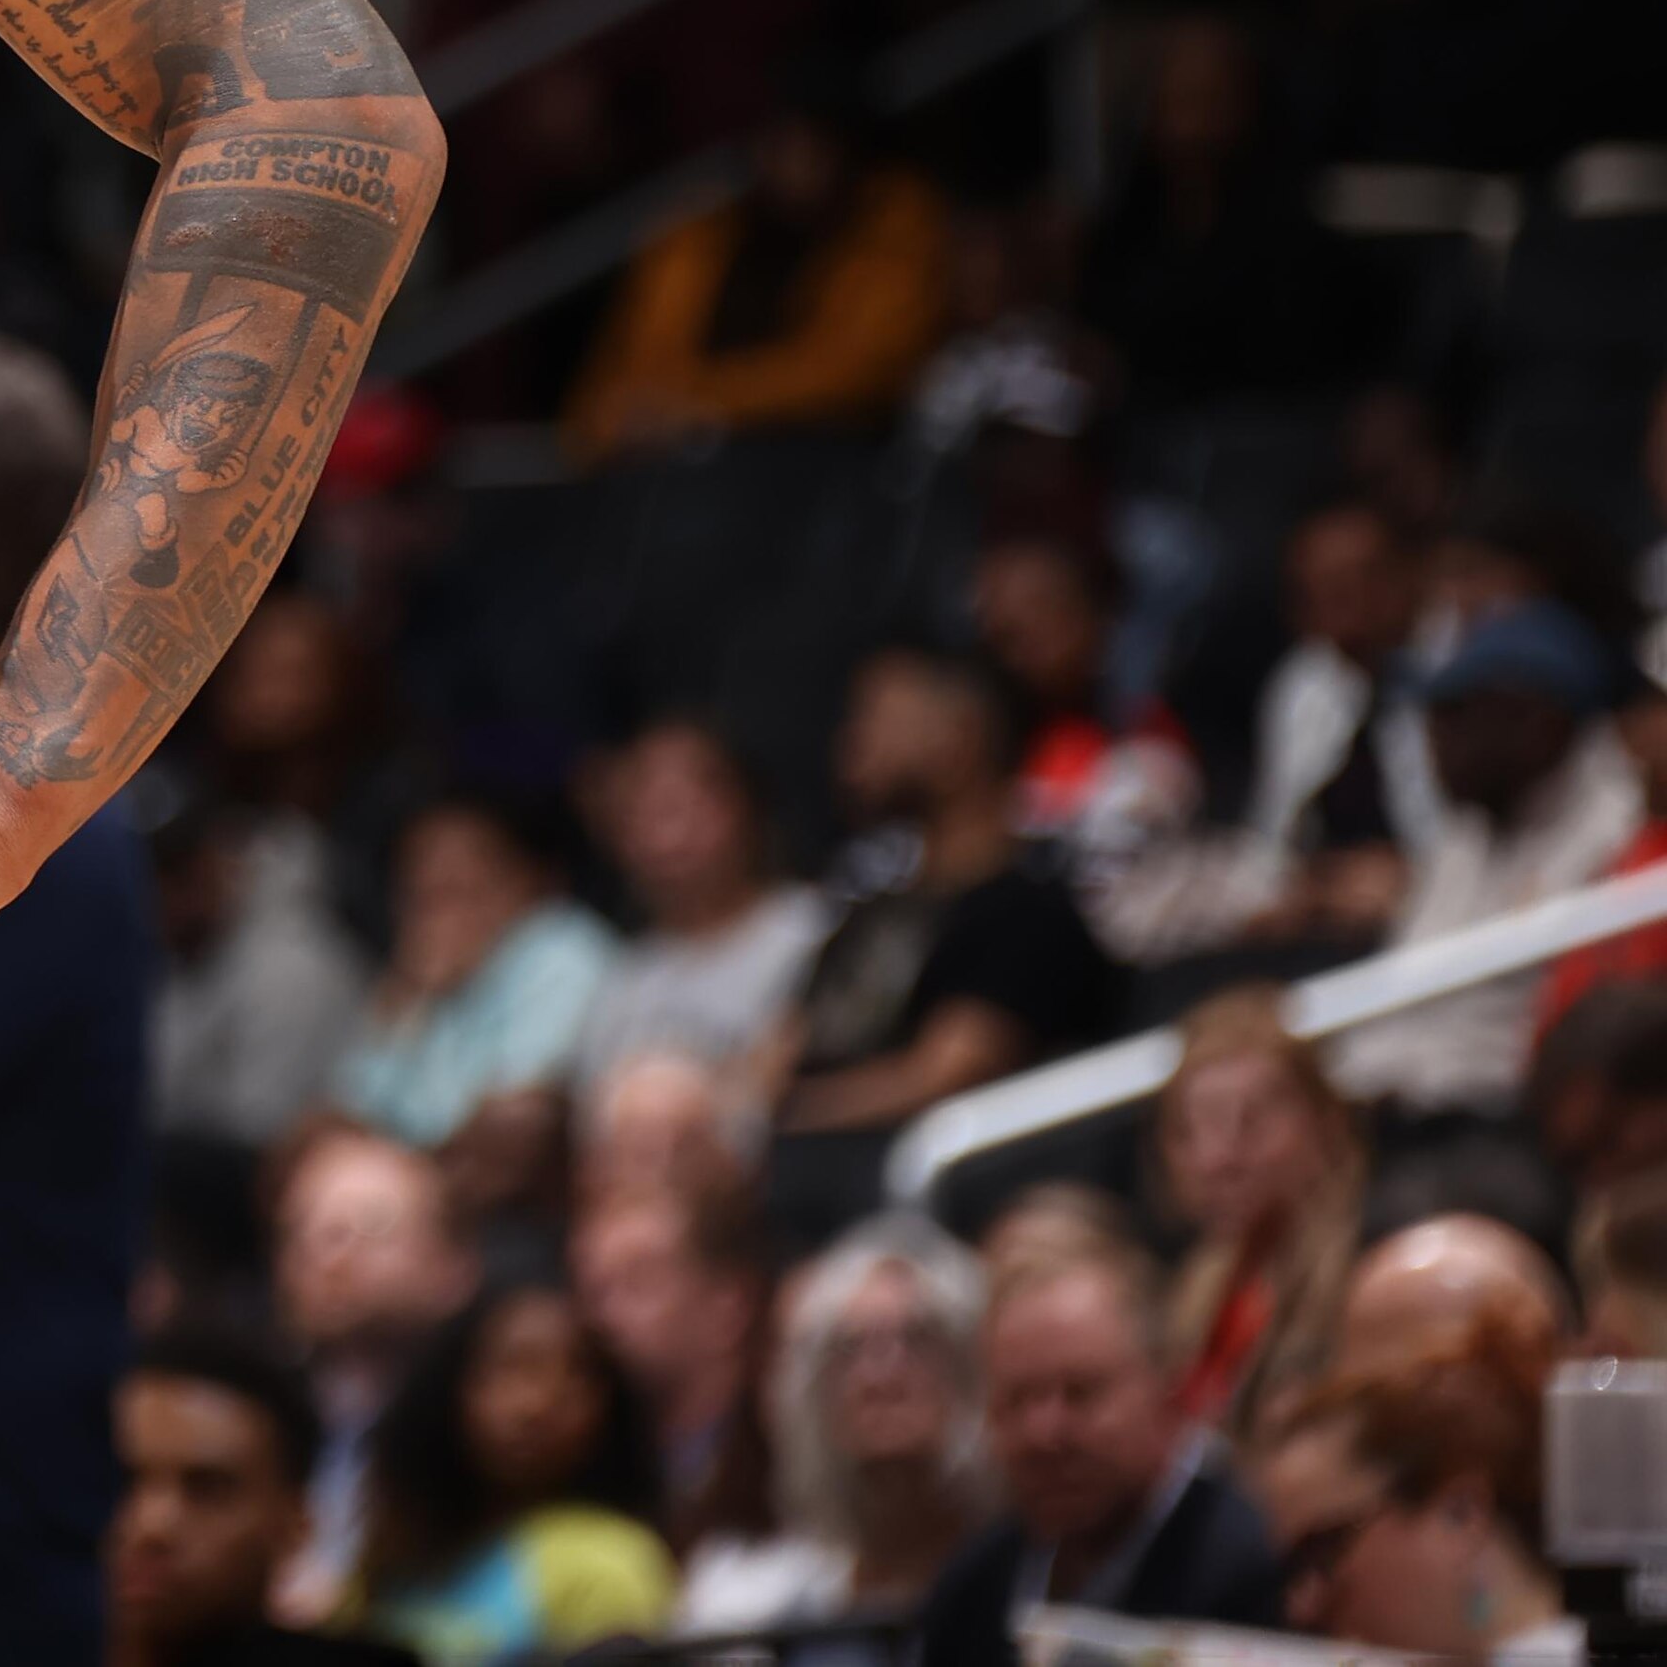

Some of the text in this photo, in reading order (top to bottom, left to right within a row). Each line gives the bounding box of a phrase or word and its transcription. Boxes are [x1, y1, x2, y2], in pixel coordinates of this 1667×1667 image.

[177, 157, 397, 212] HIGH SCHOOL
[221, 137, 391, 177] COMPTON
[223, 432, 303, 549] BLUE
[301, 322, 349, 428] CITY
